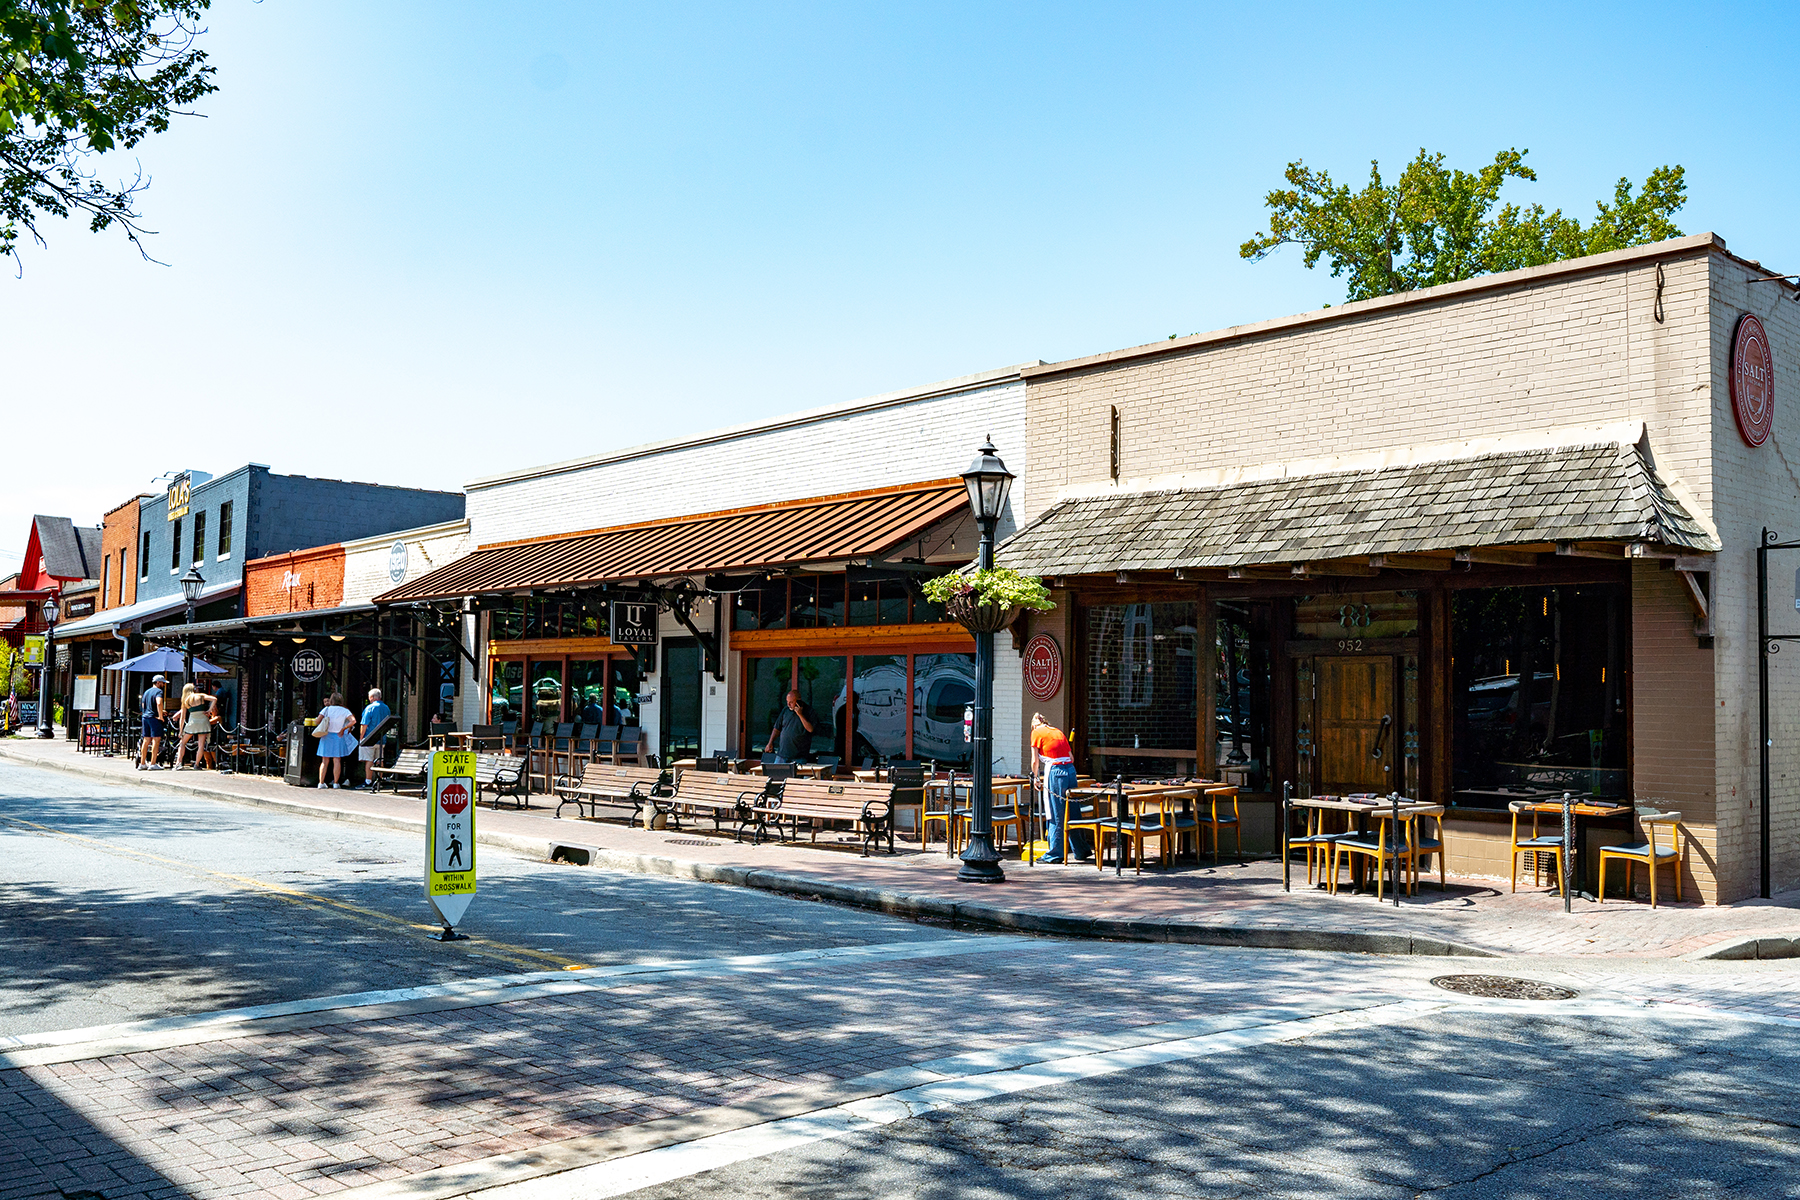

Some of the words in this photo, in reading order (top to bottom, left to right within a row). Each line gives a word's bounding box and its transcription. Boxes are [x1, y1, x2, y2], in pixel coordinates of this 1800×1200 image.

[1744, 361, 1765, 382] SALT
[168, 479, 190, 511] LOLA'S
[390, 551, 405, 571] 1920
[626, 605, 646, 627] LT
[618, 627, 653, 636] LOYAL
[1338, 639, 1363, 653] 952
[294, 657, 322, 672] 1920
[1031, 658, 1051, 667] SALT
[442, 754, 470, 764] STATE
[446, 764, 466, 775] LAW
[442, 793, 467, 805] STOP
[446, 822, 462, 831] FOR
[443, 873, 465, 882] WITHIN
[434, 882, 472, 892] CROSSWALK
